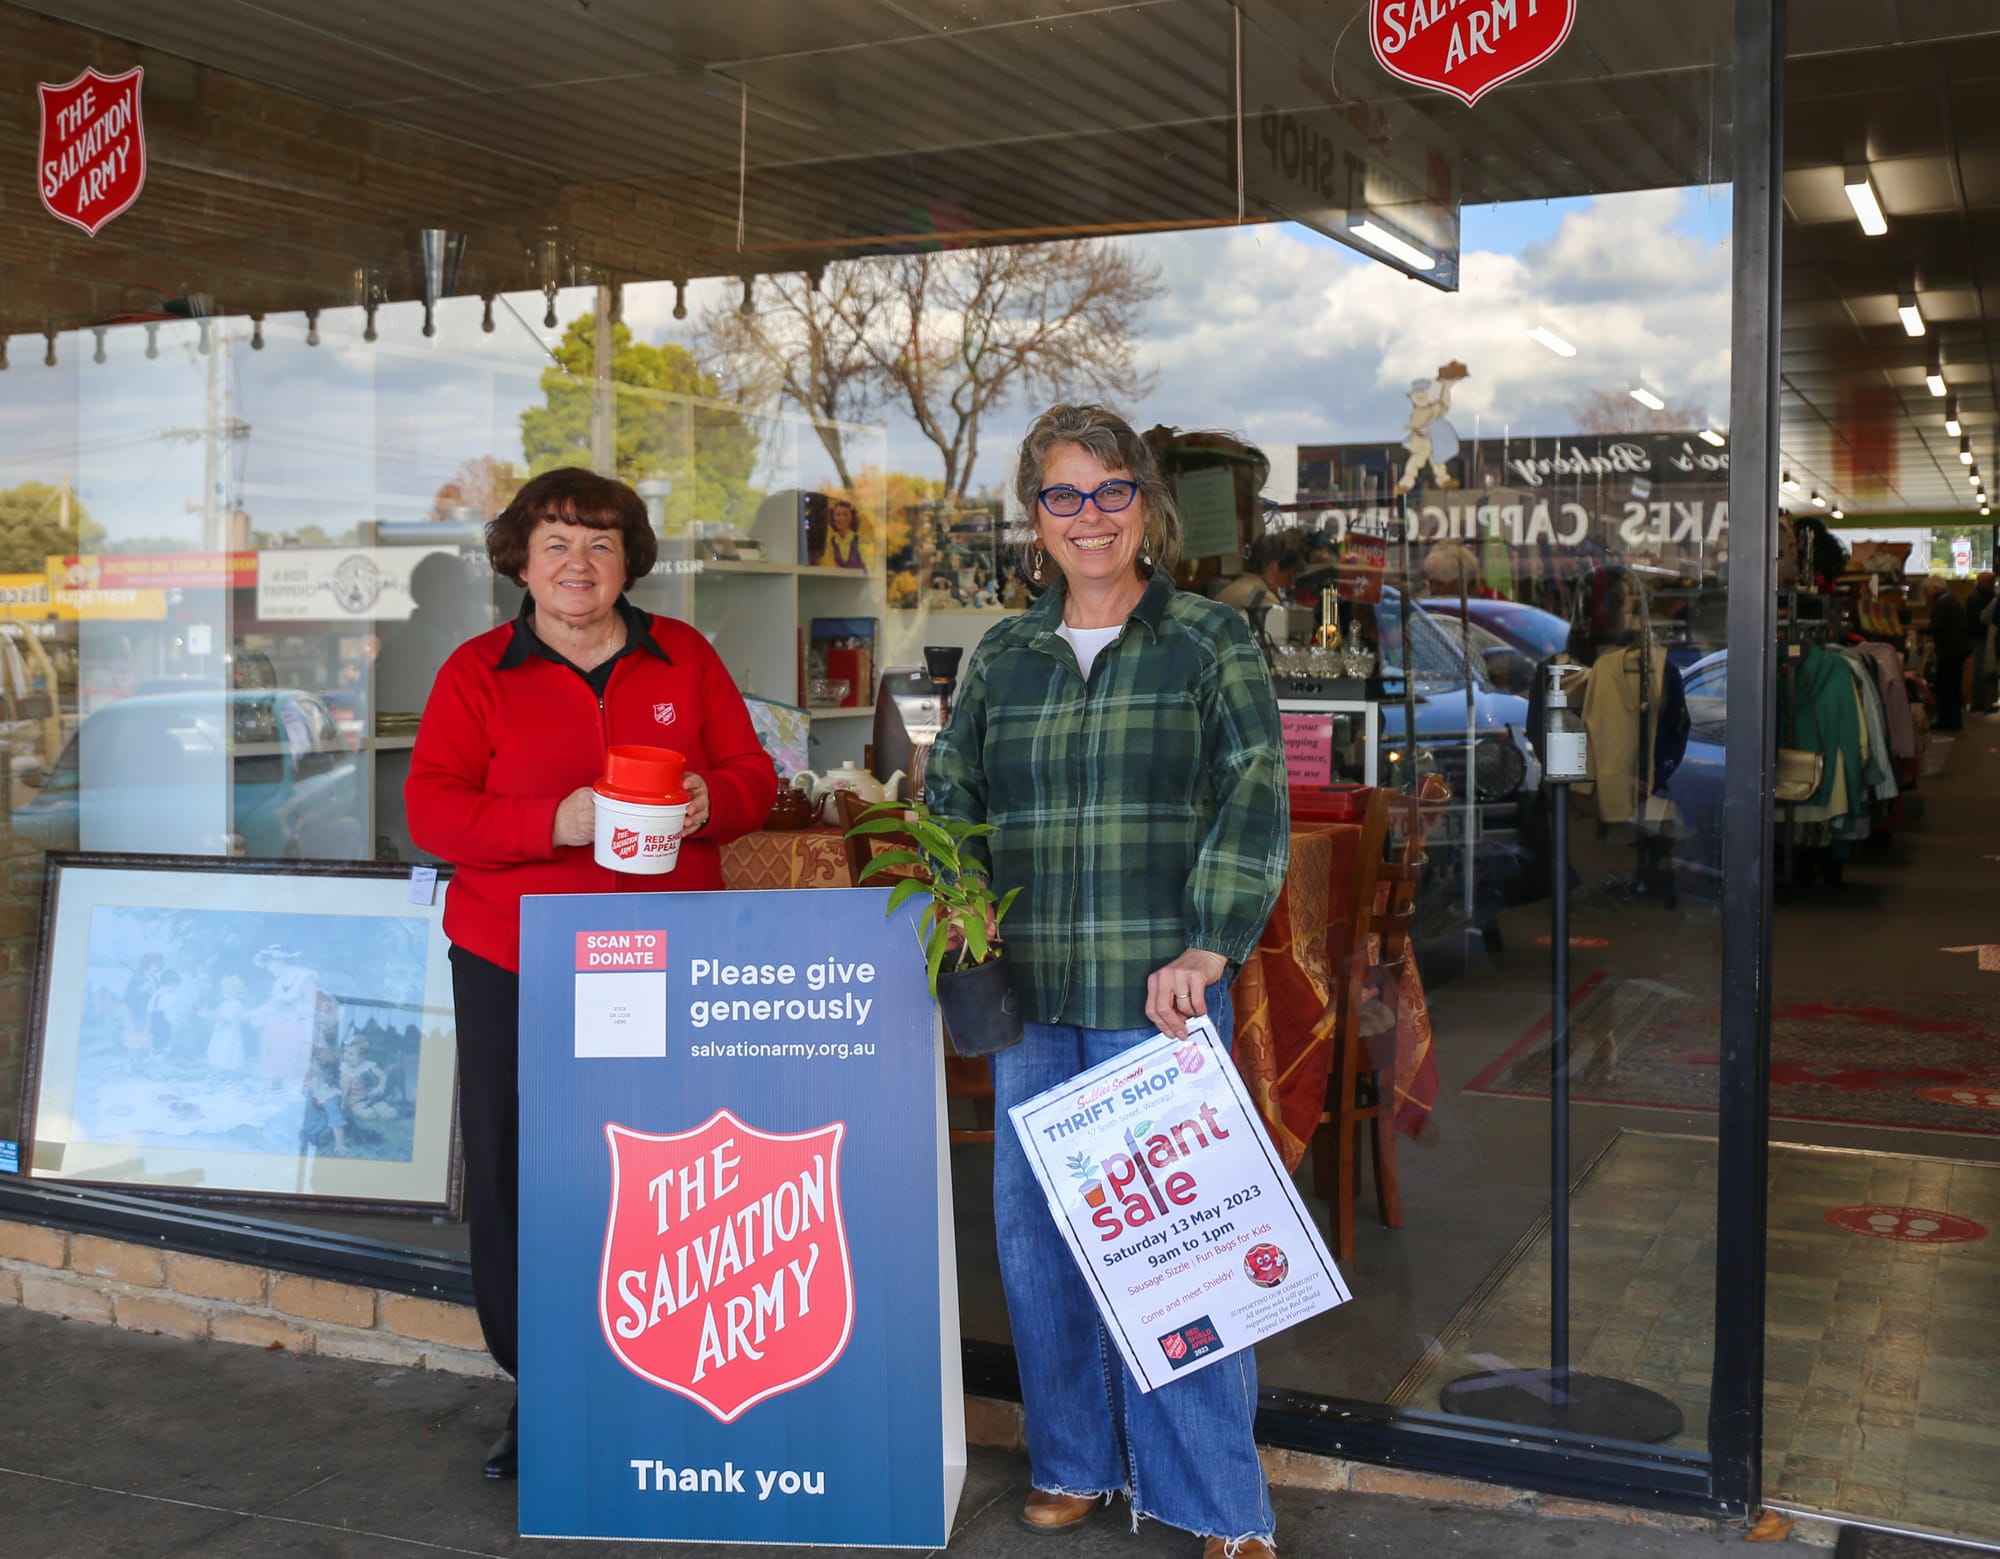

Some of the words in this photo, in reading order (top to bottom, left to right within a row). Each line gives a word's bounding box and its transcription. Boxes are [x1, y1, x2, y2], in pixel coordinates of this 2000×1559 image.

[57, 86, 96, 142] THE
[44, 88, 132, 198] SALVATION
[77, 135, 130, 213] ARMY
[1296, 724, 1319, 733] your
[613, 835, 639, 849] SALVATION
[617, 830, 629, 840] THE
[620, 843, 637, 856] ARMY
[643, 842, 676, 852] APPEAL
[644, 835, 665, 844] RED
[587, 935, 630, 949] SCAN
[634, 934, 656, 948] TO
[589, 951, 654, 965] DONATE
[691, 959, 796, 986] Please
[806, 957, 875, 990] give
[690, 993, 873, 1028] generously
[691, 1041, 875, 1059] salvationarmy.org.au
[1043, 1097, 1116, 1143] THRIFT
[1121, 1067, 1180, 1105] SHOP
[1101, 1102, 1230, 1205] plant
[649, 1138, 741, 1235] THE
[1092, 1166, 1197, 1242] sale
[616, 1154, 825, 1338] SALVATION
[1103, 1230, 1168, 1266] Saturday
[1171, 1218, 1190, 1236] 13
[1190, 1205, 1221, 1227] May
[1223, 1185, 1262, 1210] 2023
[1148, 1248, 1181, 1268] 9am
[1182, 1238, 1199, 1252] to
[1202, 1221, 1235, 1244] 1pm
[1127, 1272, 1164, 1296] Sausage
[1165, 1259, 1191, 1278] Sizzle
[1195, 1251, 1214, 1264] Fun
[1214, 1241, 1237, 1255] Bags
[1237, 1232, 1251, 1245] for
[1252, 1223, 1272, 1238] Kids
[692, 1242, 819, 1384] ARMY
[1141, 1308, 1164, 1325] Come
[1166, 1298, 1182, 1312] and
[1182, 1288, 1203, 1304] meet
[1202, 1268, 1234, 1291] Shieldy!
[1230, 1295, 1268, 1317] SUPPORTING
[1268, 1291, 1282, 1300] OUR
[1282, 1272, 1319, 1293] COMMUNITY
[1245, 1310, 1254, 1320] All
[1255, 1305, 1272, 1316] items
[1272, 1299, 1285, 1307] sold
[1297, 1288, 1306, 1297] go
[1246, 1311, 1279, 1330] supporting
[1279, 1305, 1289, 1314] the
[1289, 1300, 1301, 1309] Red
[1301, 1289, 1321, 1303] Shield
[1257, 1320, 1279, 1334] Appeal
[630, 1460, 745, 1493] Thank
[754, 1470, 825, 1500] you
